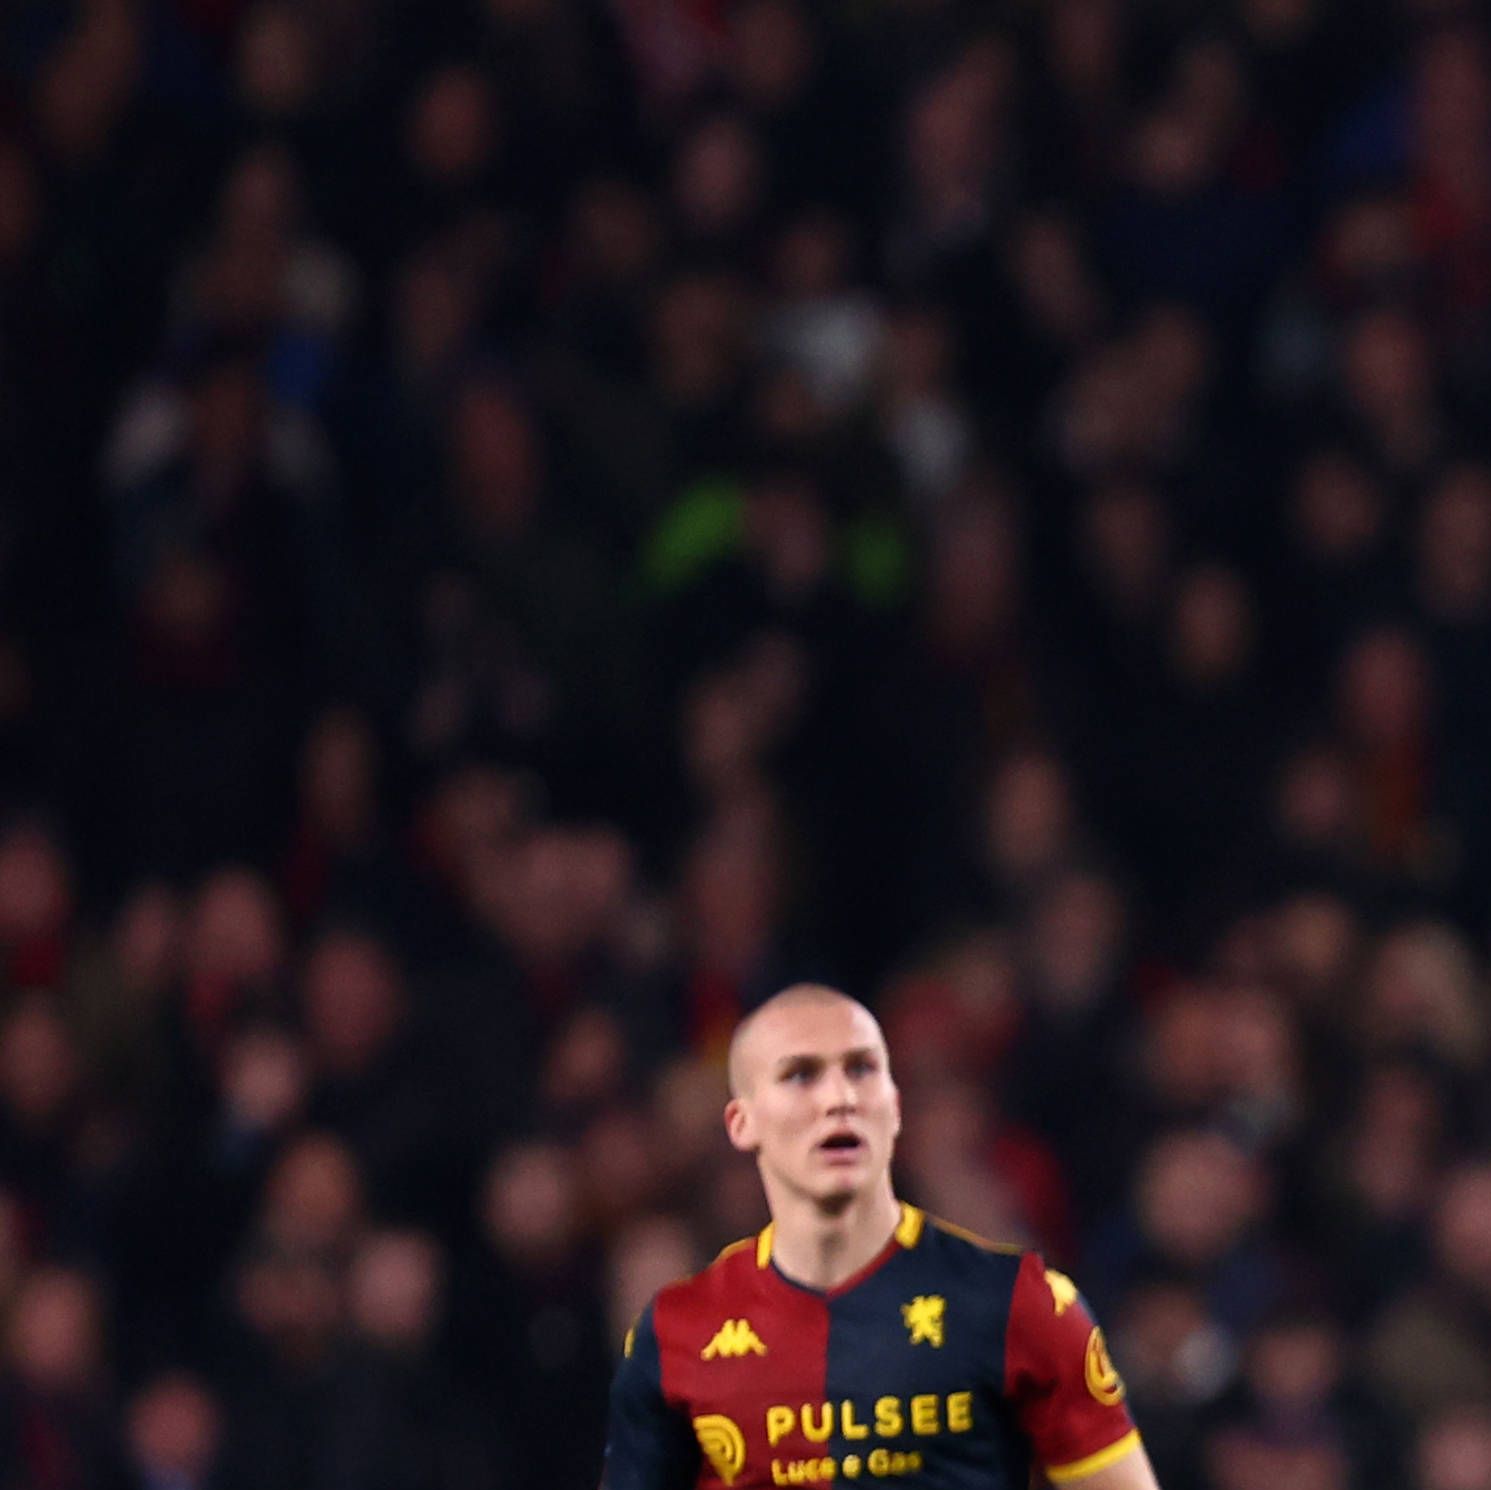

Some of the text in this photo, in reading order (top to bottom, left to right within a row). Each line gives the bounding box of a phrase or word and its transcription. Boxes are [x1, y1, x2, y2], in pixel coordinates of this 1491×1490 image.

[766, 1391, 974, 1446] PULSEE
[771, 1448, 923, 1486] Luce e Gas
